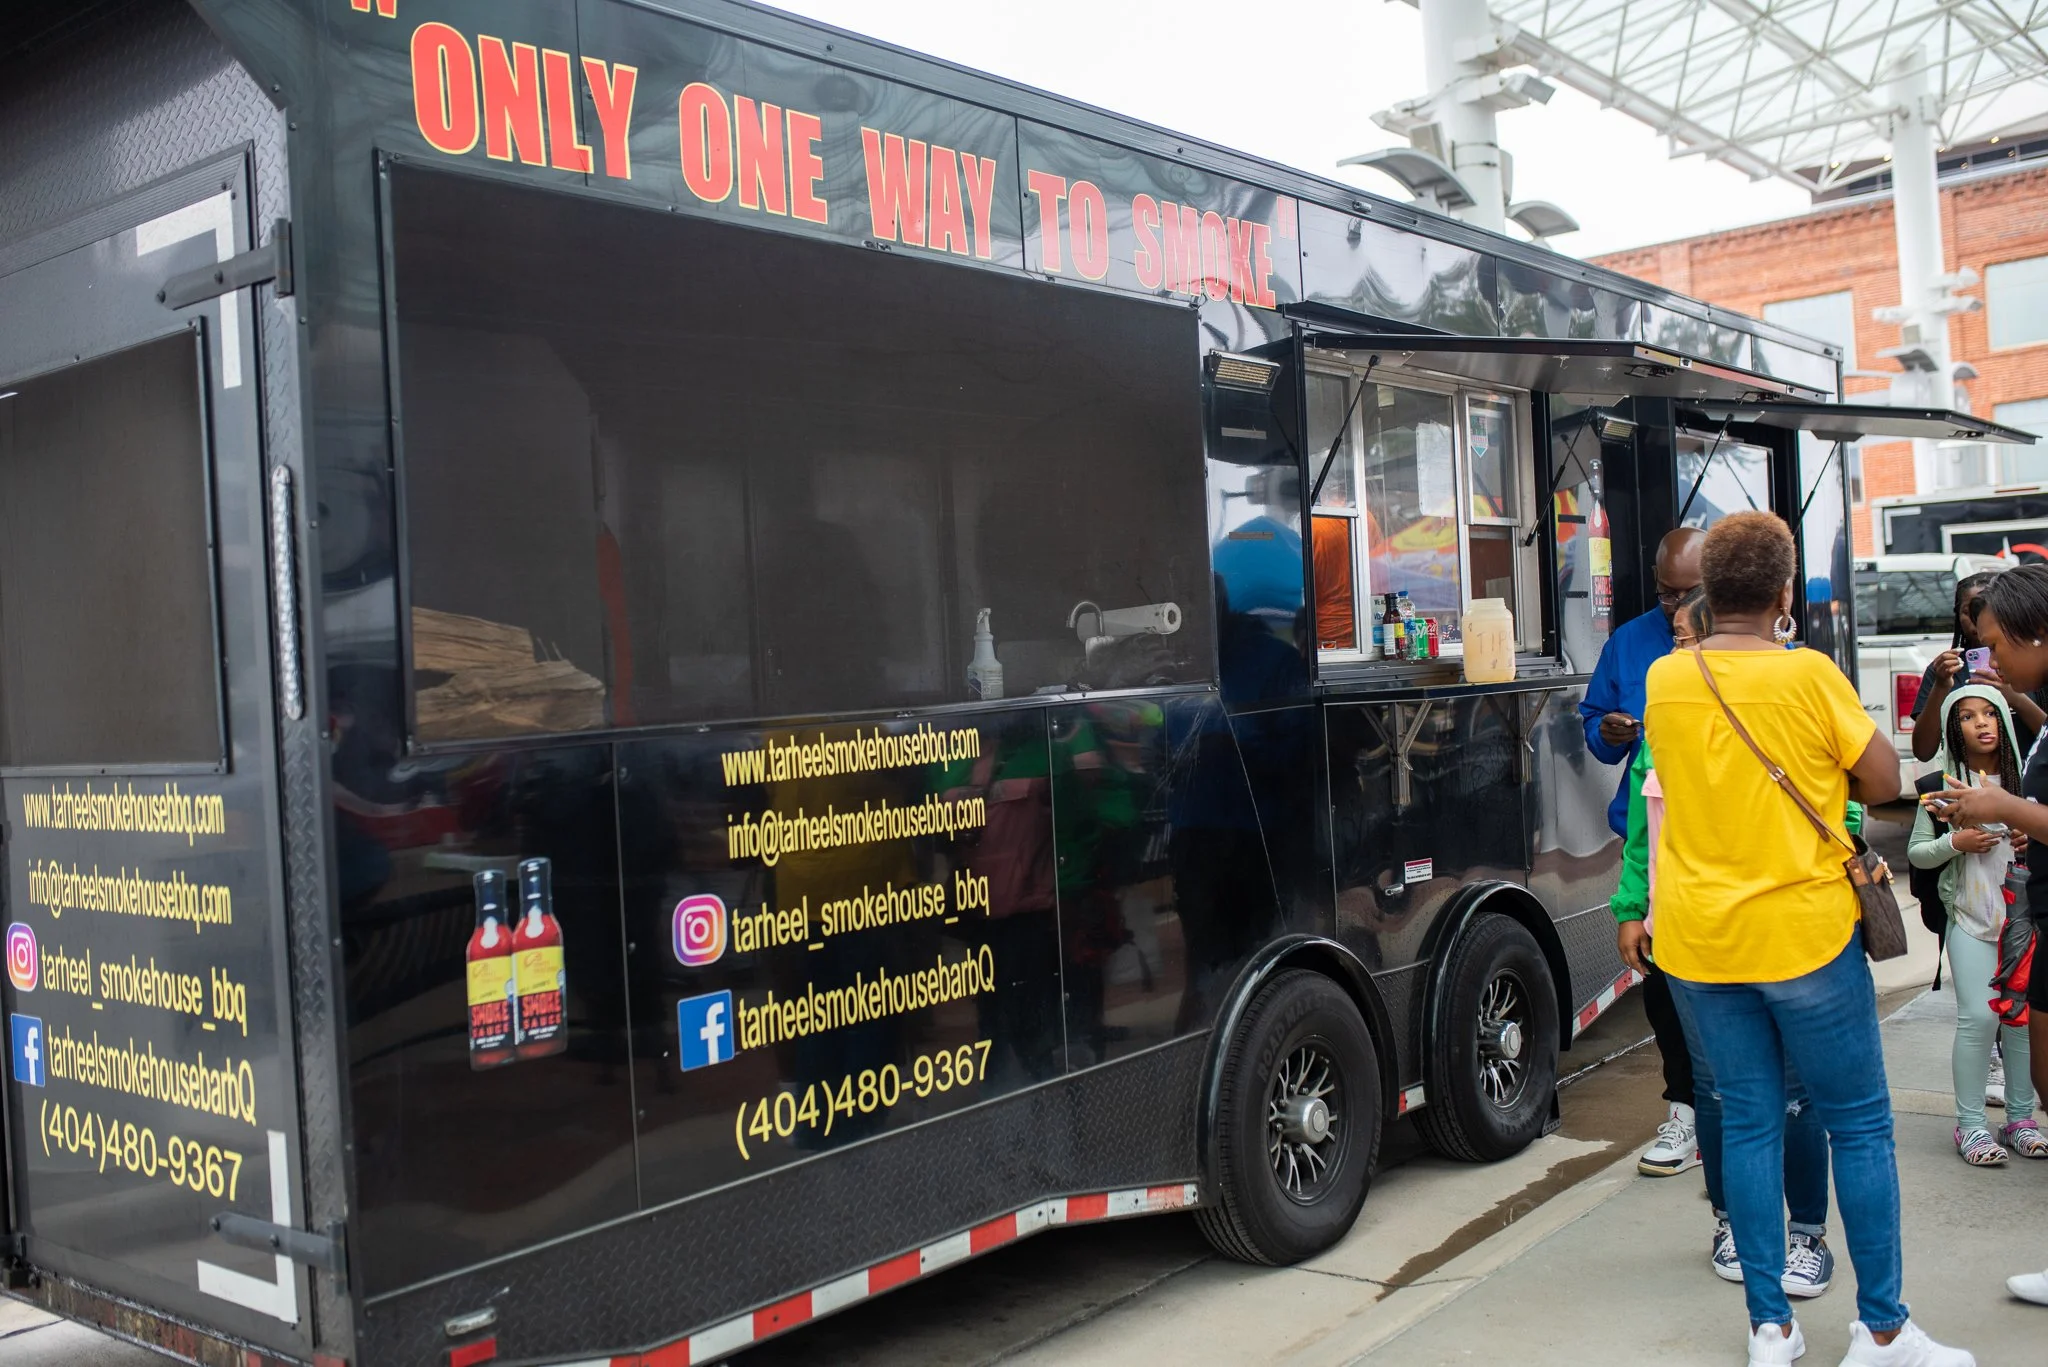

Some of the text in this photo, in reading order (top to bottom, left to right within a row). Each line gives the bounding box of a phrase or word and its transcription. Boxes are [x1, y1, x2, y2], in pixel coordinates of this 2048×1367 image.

[678, 82, 828, 225] ONE
[860, 126, 997, 260] WAY
[1027, 169, 1109, 280] TO
[722, 722, 980, 786] www.tarheelsmokehousebbq.com
[23, 782, 226, 847] www.tarheelsmokehousebbq.com
[728, 793, 986, 867] info@tarheelsmokehousebbq.com
[28, 860, 232, 934] info@tarheelsmokehousebbq.com
[732, 868, 990, 953] tarheel_smokehouse_bbq
[41, 944, 248, 1037] tarheel_smokehouse_bbq
[472, 1000, 510, 1027] SMOKE
[522, 990, 562, 1018] SMOKE
[523, 1013, 562, 1030] SAUCE
[738, 943, 996, 1050] tarheelsmokehousebarbQ
[472, 1022, 510, 1039] SAUCE
[48, 1025, 257, 1126] tarheelsmokehousebarbQ
[735, 1039, 993, 1160] (404)480-9367
[41, 1099, 243, 1201] (404)480-9367
